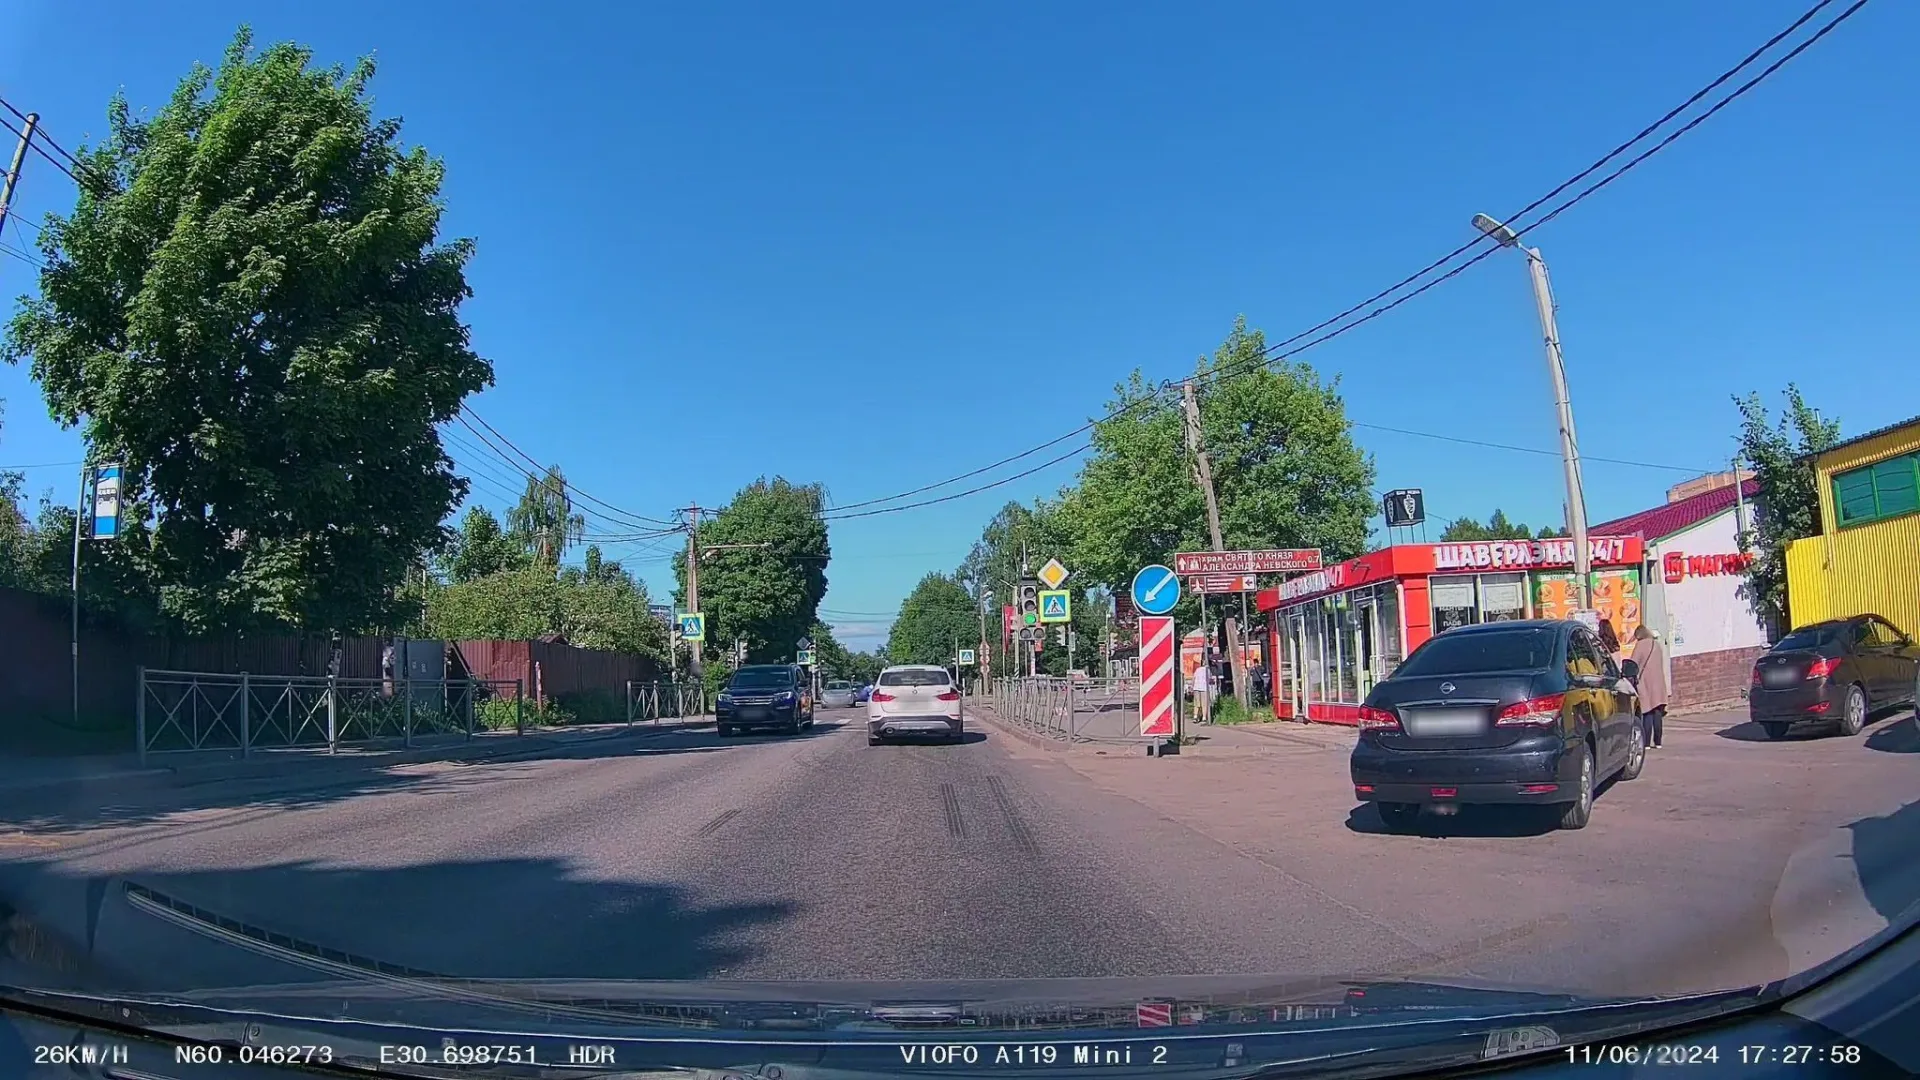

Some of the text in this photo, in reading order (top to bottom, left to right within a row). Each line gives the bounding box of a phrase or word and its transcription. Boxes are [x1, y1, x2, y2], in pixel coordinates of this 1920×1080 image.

[1225, 552, 1263, 562] СВЯТОГО
[1265, 551, 1293, 560] КНЯЗЯ
[1202, 559, 1307, 571] АЛЕКСАНДРА НЕВСКОГО
